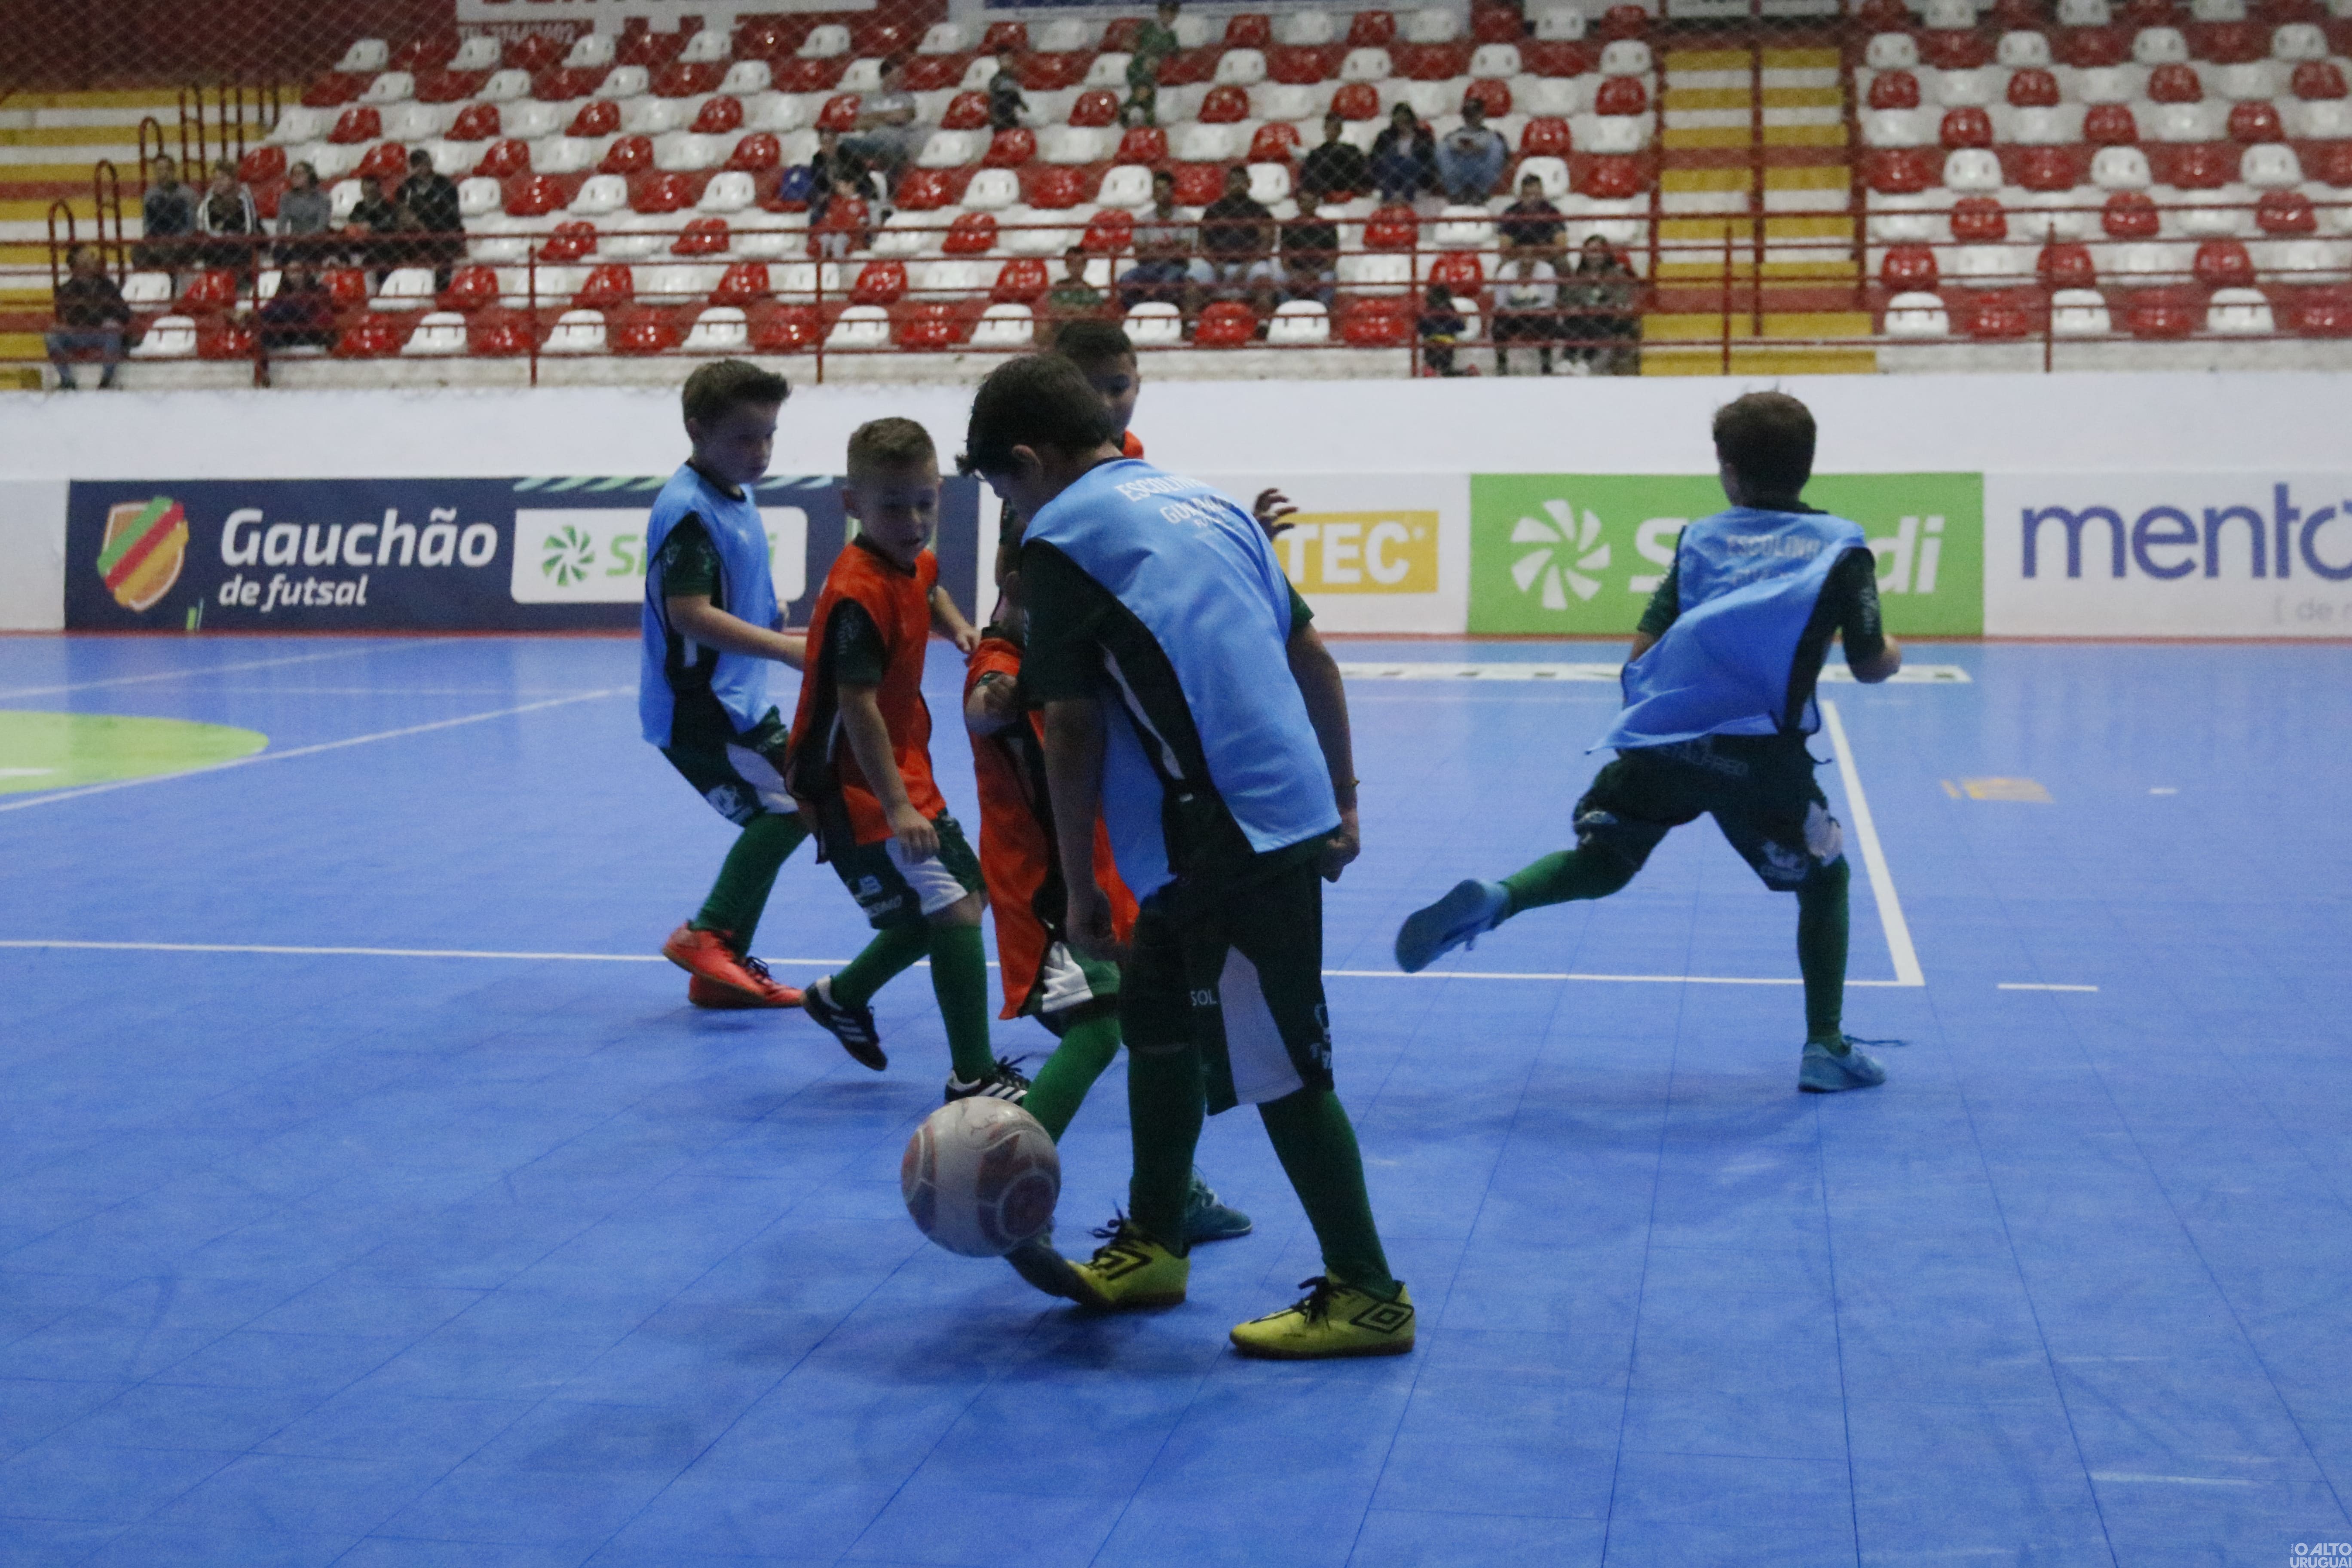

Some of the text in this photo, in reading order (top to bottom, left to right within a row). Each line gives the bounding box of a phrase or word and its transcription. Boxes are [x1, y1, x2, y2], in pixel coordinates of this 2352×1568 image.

[221, 507, 499, 567] Gauchão
[219, 573, 368, 612] de futsal
[1189, 989, 1218, 1007] SOL
